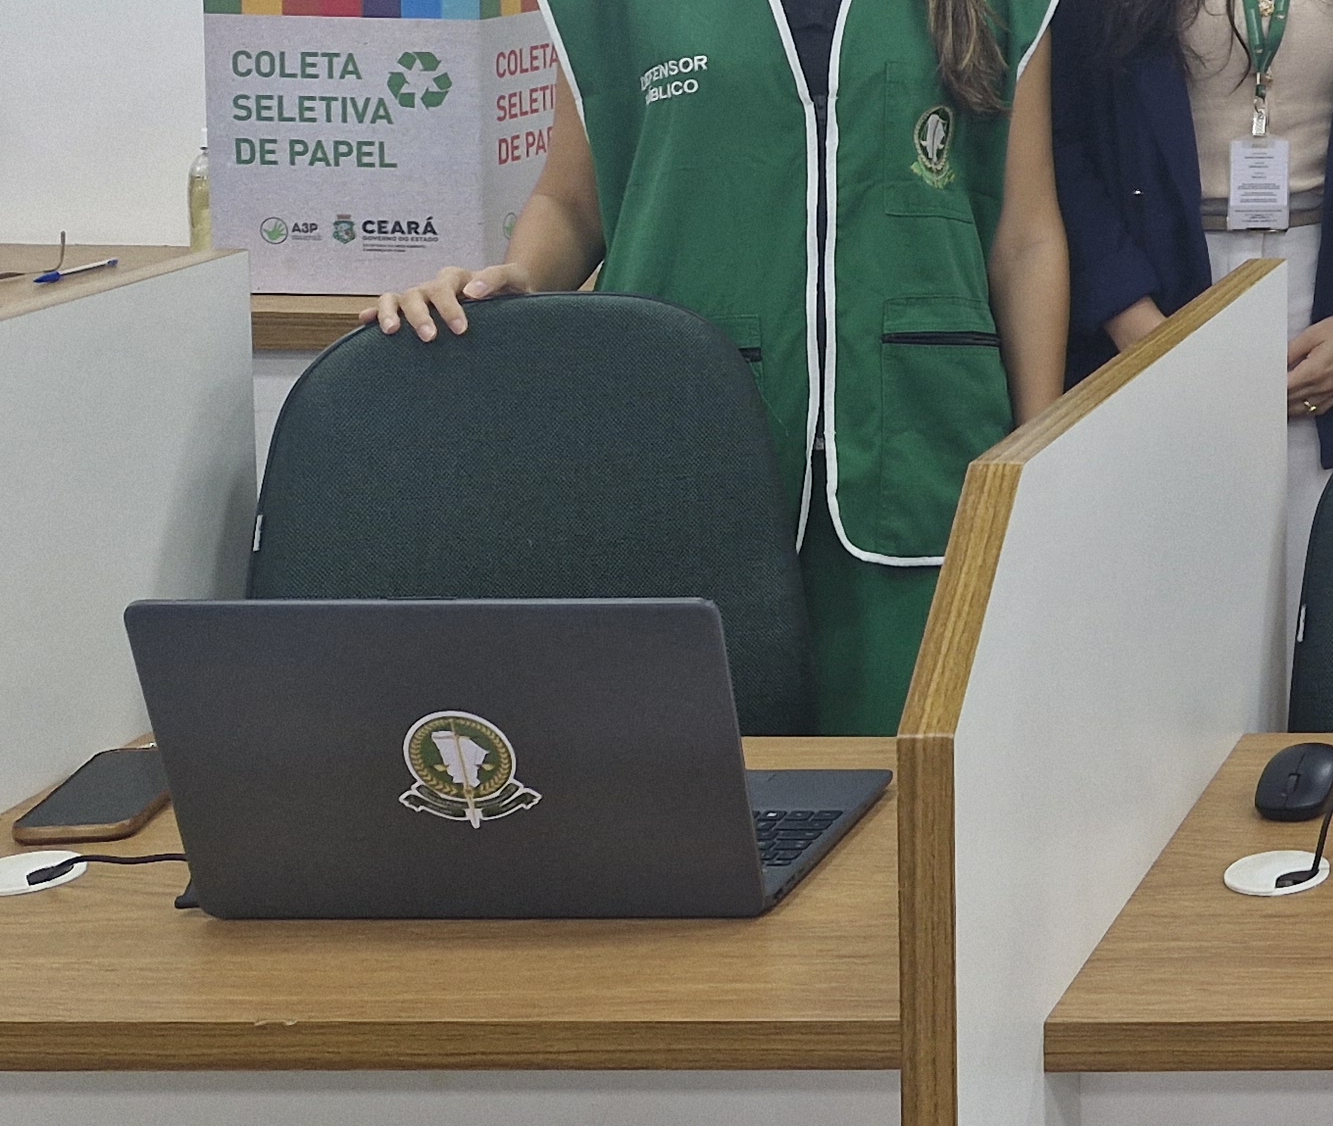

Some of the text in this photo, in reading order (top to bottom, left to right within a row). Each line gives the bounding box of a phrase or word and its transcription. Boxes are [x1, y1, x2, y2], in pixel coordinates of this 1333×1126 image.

[231, 50, 363, 80] COLETA
[232, 94, 394, 125] SELETIVA
[496, 83, 556, 122] SELETI
[234, 137, 398, 168] DE PAPEL
[498, 134, 521, 165] DE
[291, 222, 318, 234] A3P
[362, 216, 438, 236] CEARÁ
